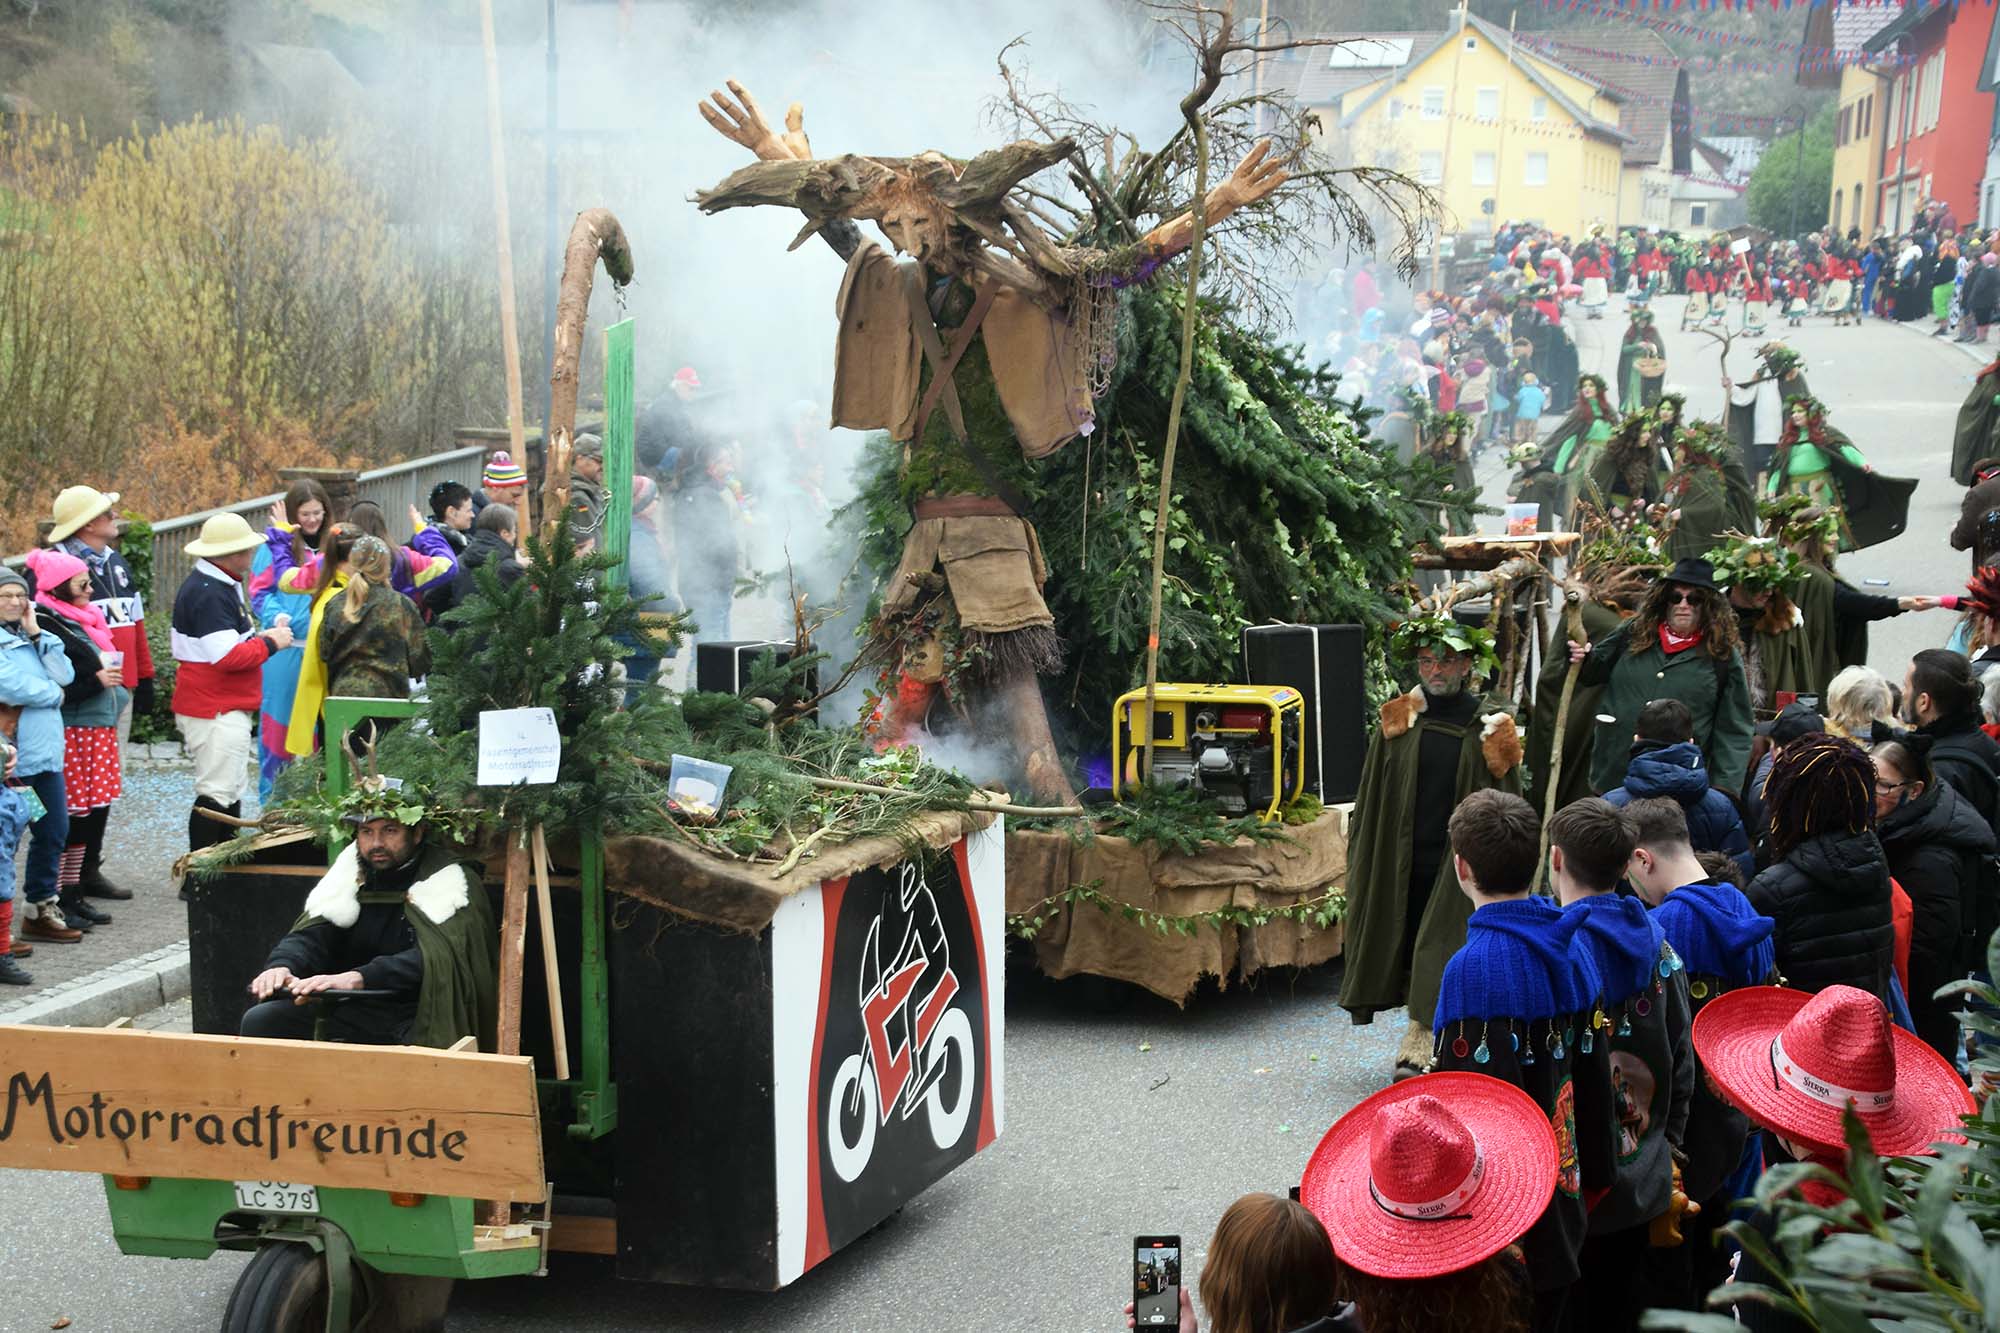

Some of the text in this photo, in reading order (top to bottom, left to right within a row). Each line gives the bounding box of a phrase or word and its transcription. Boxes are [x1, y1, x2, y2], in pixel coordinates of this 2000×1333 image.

[1803, 1076, 1830, 1096] SIERRA
[0, 1072, 467, 1161] Motorradfreunde
[241, 1189, 313, 1209] LC 379
[1417, 1202, 1447, 1215] SIERRA
